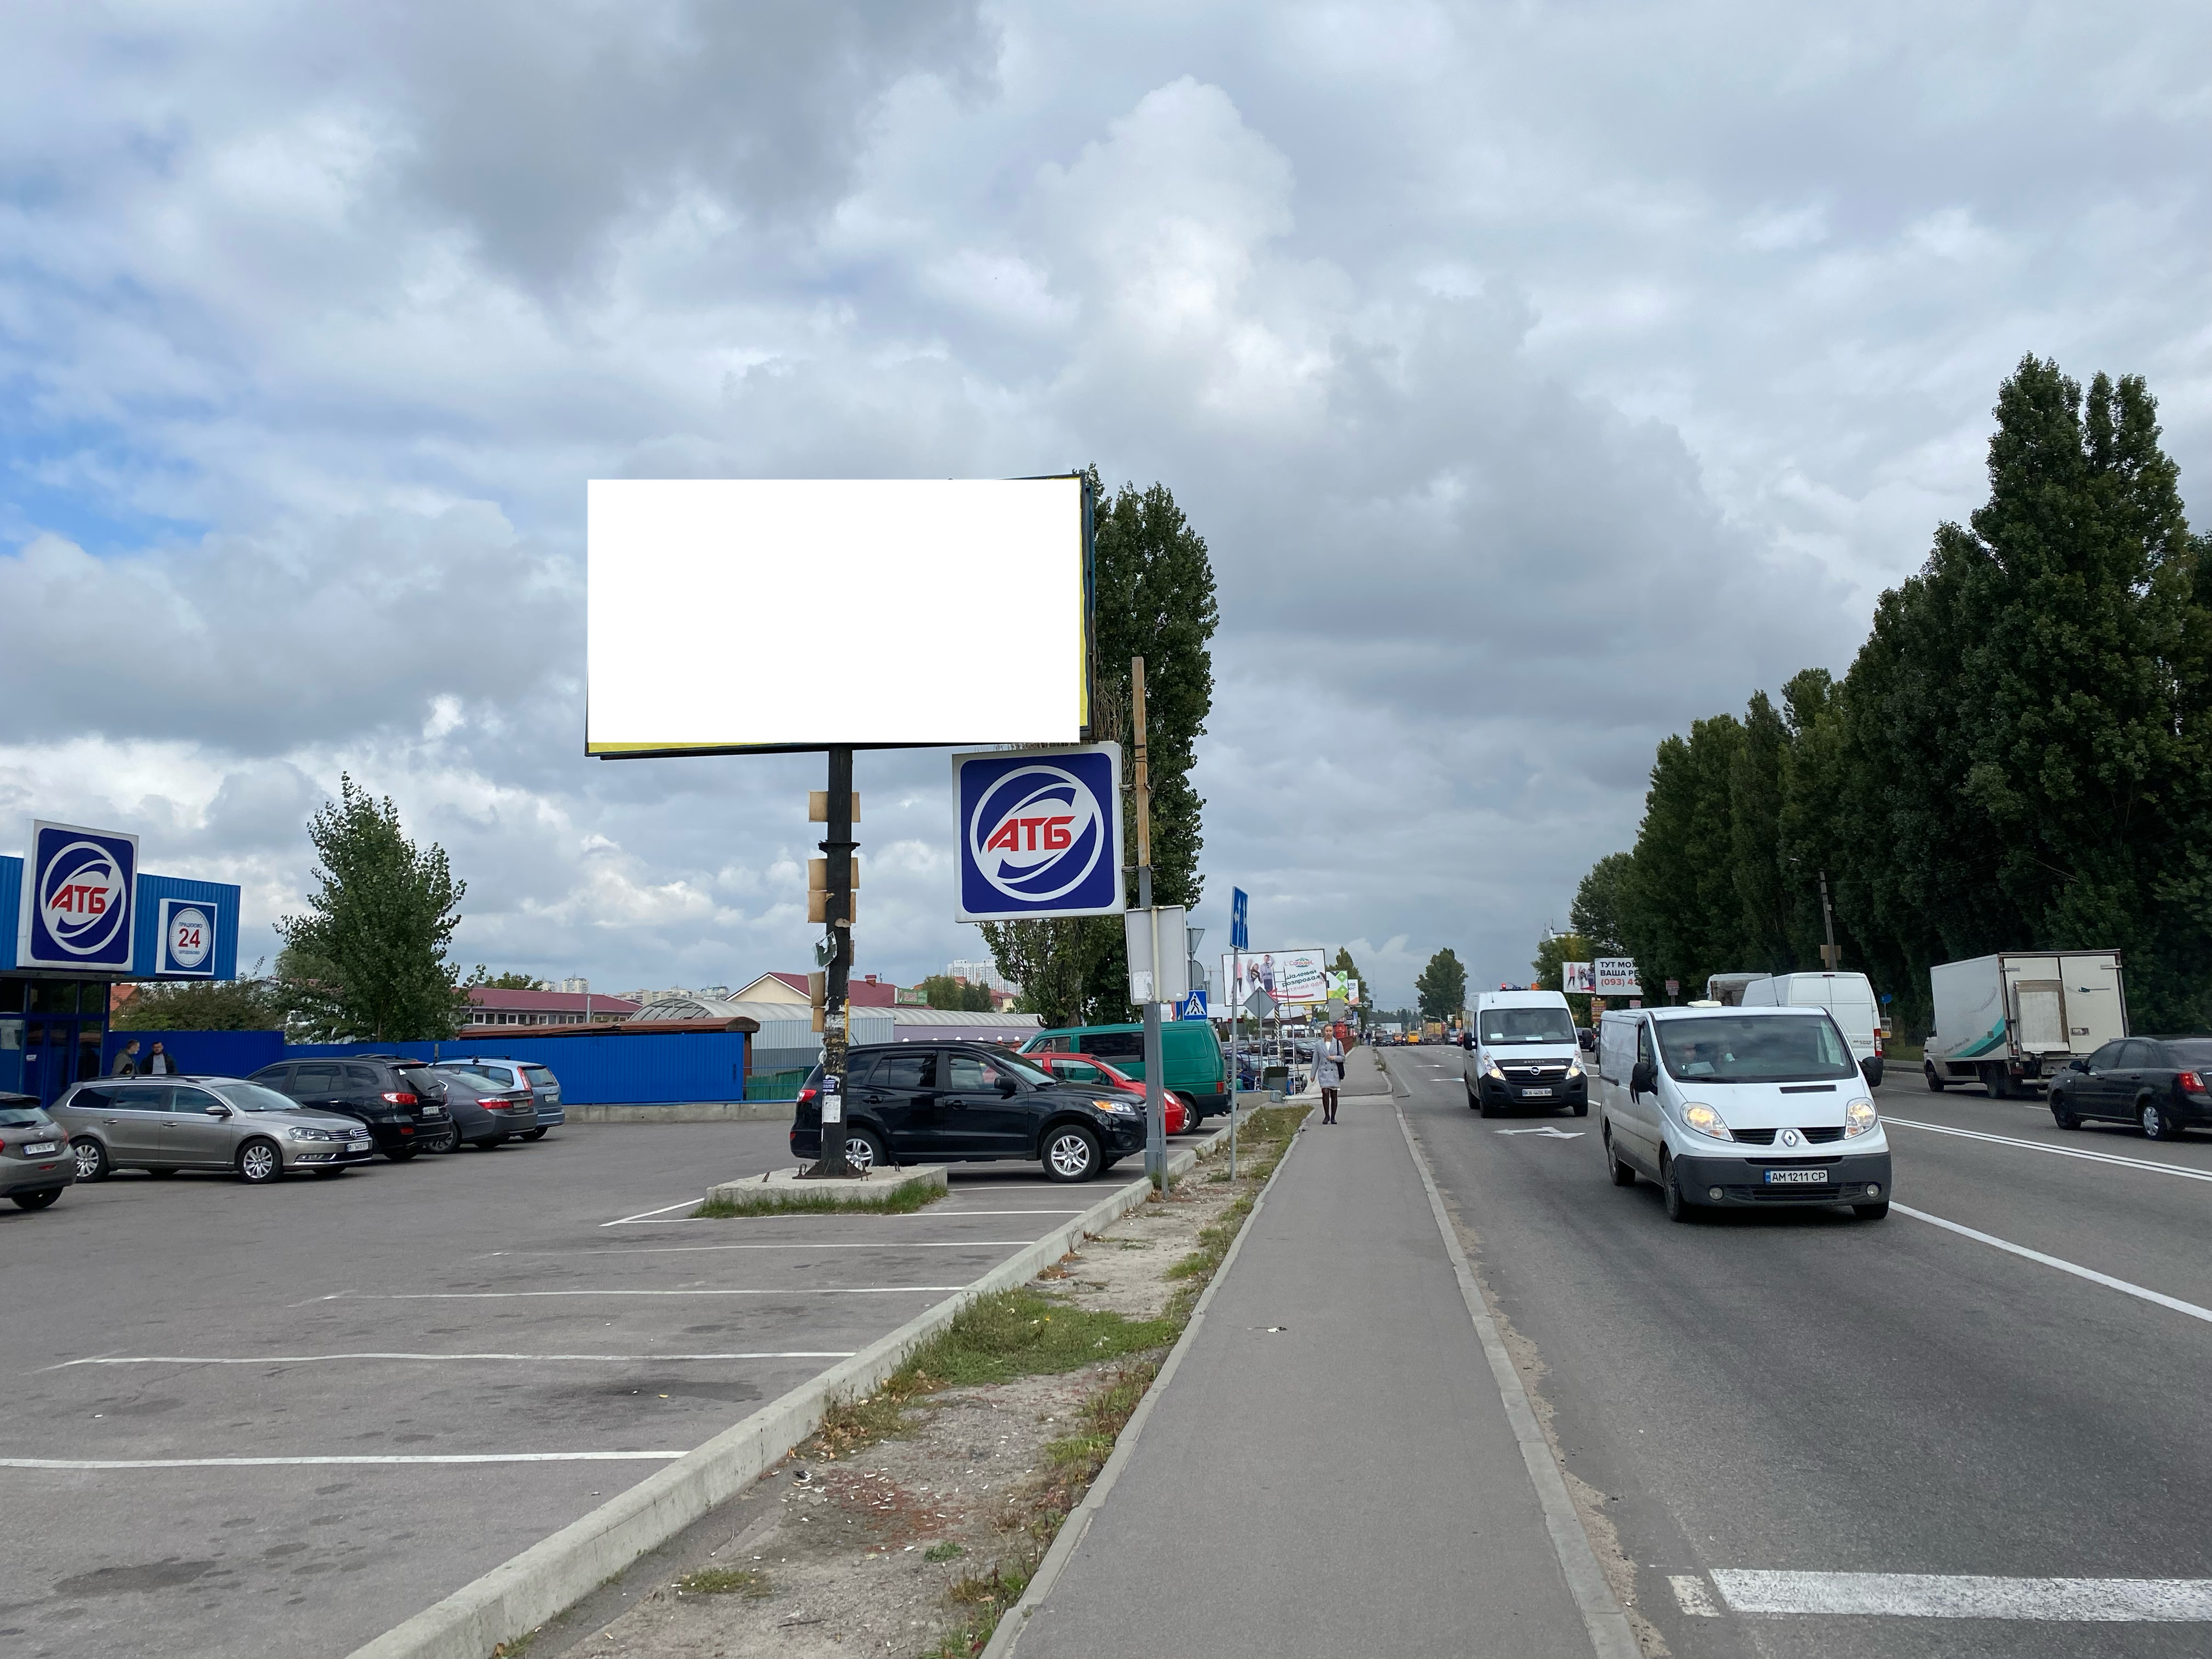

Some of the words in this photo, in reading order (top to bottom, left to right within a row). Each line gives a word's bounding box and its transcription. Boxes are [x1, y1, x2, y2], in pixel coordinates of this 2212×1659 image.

[987, 815, 1076, 853] АТБ
[51, 884, 110, 914] АТБ
[178, 928, 200, 948] 24
[1601, 978, 1625, 987] (093)
[1772, 1173, 1786, 1182] AM
[1788, 1172, 1808, 1182] 1211
[1812, 1172, 1825, 1181] CP
